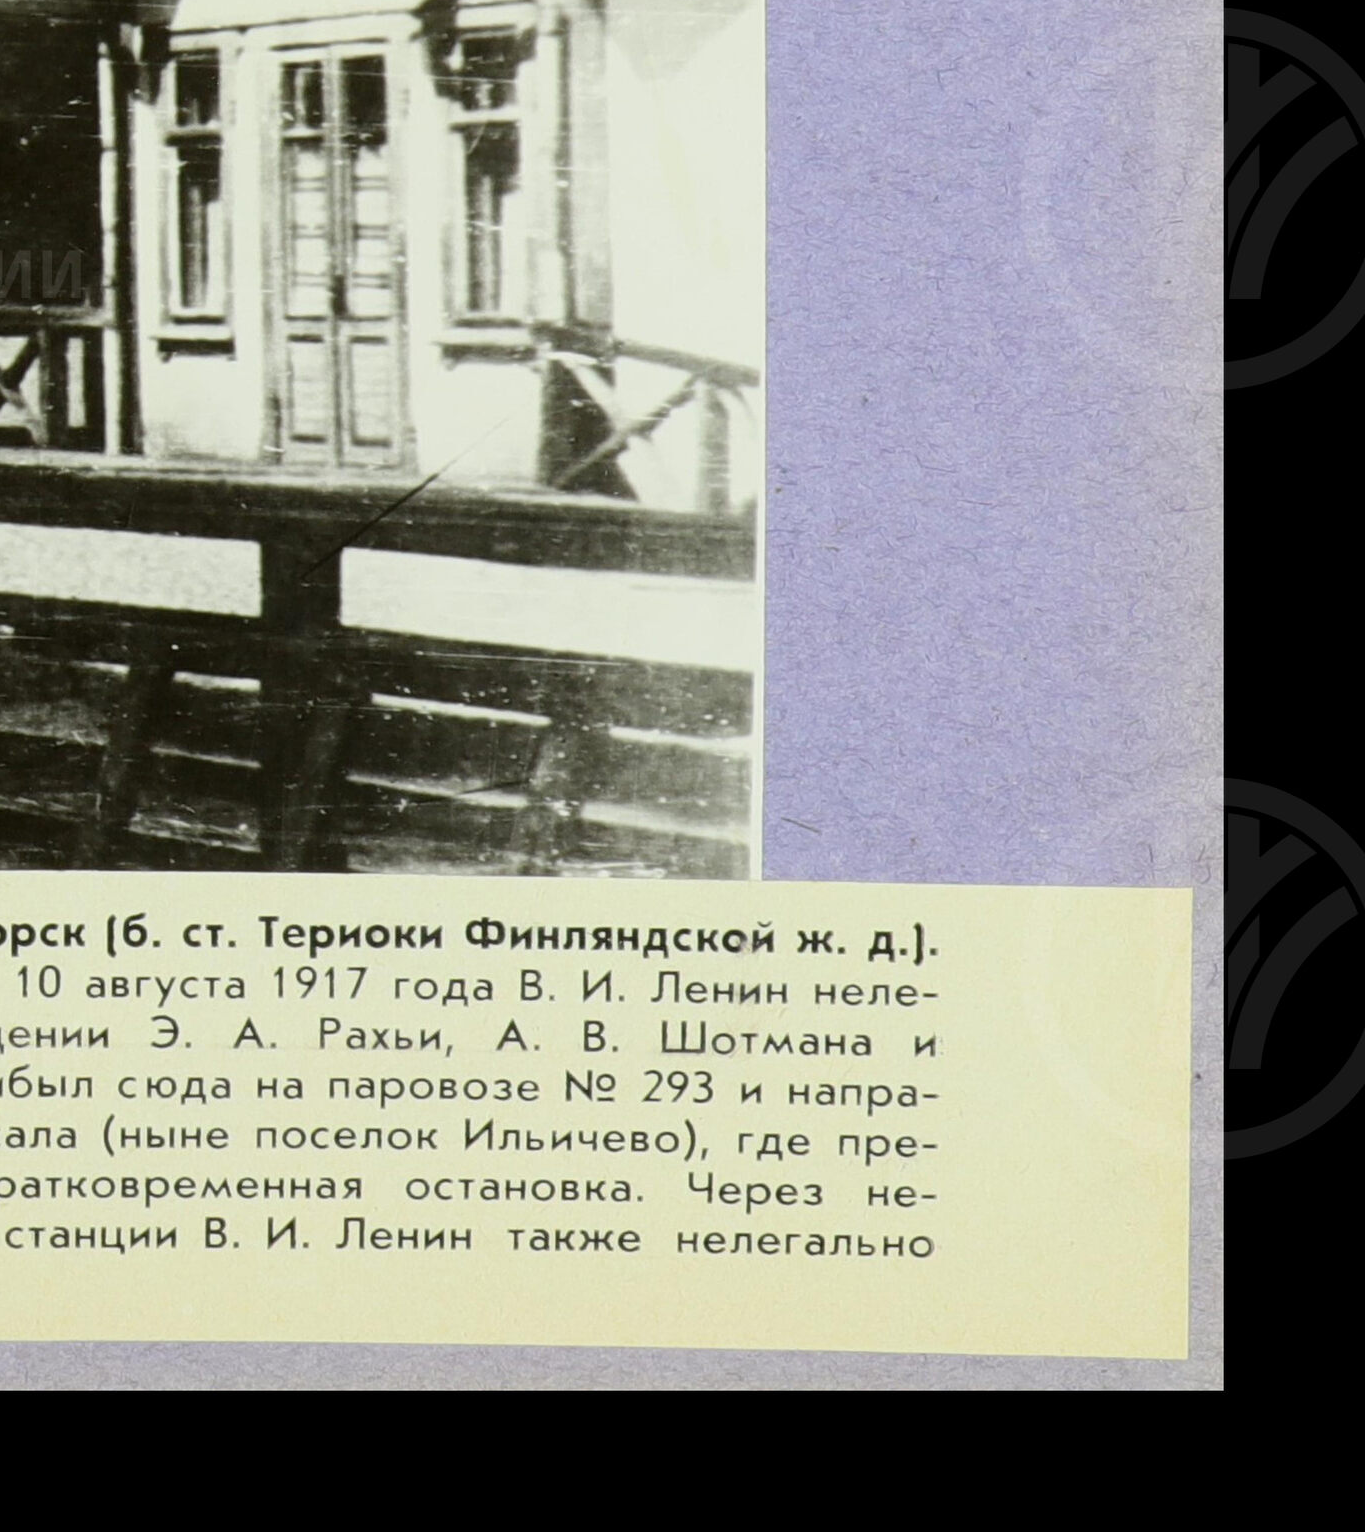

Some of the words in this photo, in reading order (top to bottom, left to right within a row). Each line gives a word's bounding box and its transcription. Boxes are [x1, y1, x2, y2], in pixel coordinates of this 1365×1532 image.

[182, 923, 237, 948] ст.
[258, 915, 443, 959] Териоки
[465, 916, 775, 959] Финляндской
[796, 930, 846, 955] ж.
[17, 964, 62, 999] 10
[85, 976, 245, 1008] августа
[273, 965, 368, 999] 1917
[394, 977, 494, 1007] года
[520, 968, 555, 1002] В.
[582, 969, 625, 1003] И.
[650, 970, 788, 1005] Ленин
[814, 983, 938, 1007] неле-
[150, 1014, 192, 1049] Э.
[233, 1017, 277, 1049] А.
[319, 1016, 453, 1058] Рахьи,
[496, 1019, 540, 1051] А.
[583, 1019, 619, 1053] В.
[661, 1020, 872, 1057] Шотмана
[914, 1035, 936, 1057] и
[117, 1076, 231, 1105] сюда
[257, 1077, 303, 1100] на
[329, 1077, 540, 1109] паровозе
[565, 1069, 616, 1102] №
[642, 1069, 714, 1104] 293
[740, 1083, 762, 1104] и
[788, 1083, 939, 1117] напра-
[103, 1113, 229, 1157] (ныне
[256, 1126, 438, 1151] поселок
[464, 1118, 708, 1162] Ильичево),
[738, 1132, 810, 1161] где
[839, 1134, 938, 1167] пре-
[405, 1178, 643, 1203] остановка.
[688, 1171, 823, 1215] Через
[868, 1185, 937, 1208] не-
[4, 1226, 177, 1255] станции
[204, 1216, 240, 1249] В.
[267, 1216, 309, 1250] И.
[335, 1216, 472, 1250] Ленин
[507, 1228, 641, 1253] также
[677, 1231, 935, 1259] нелегально
